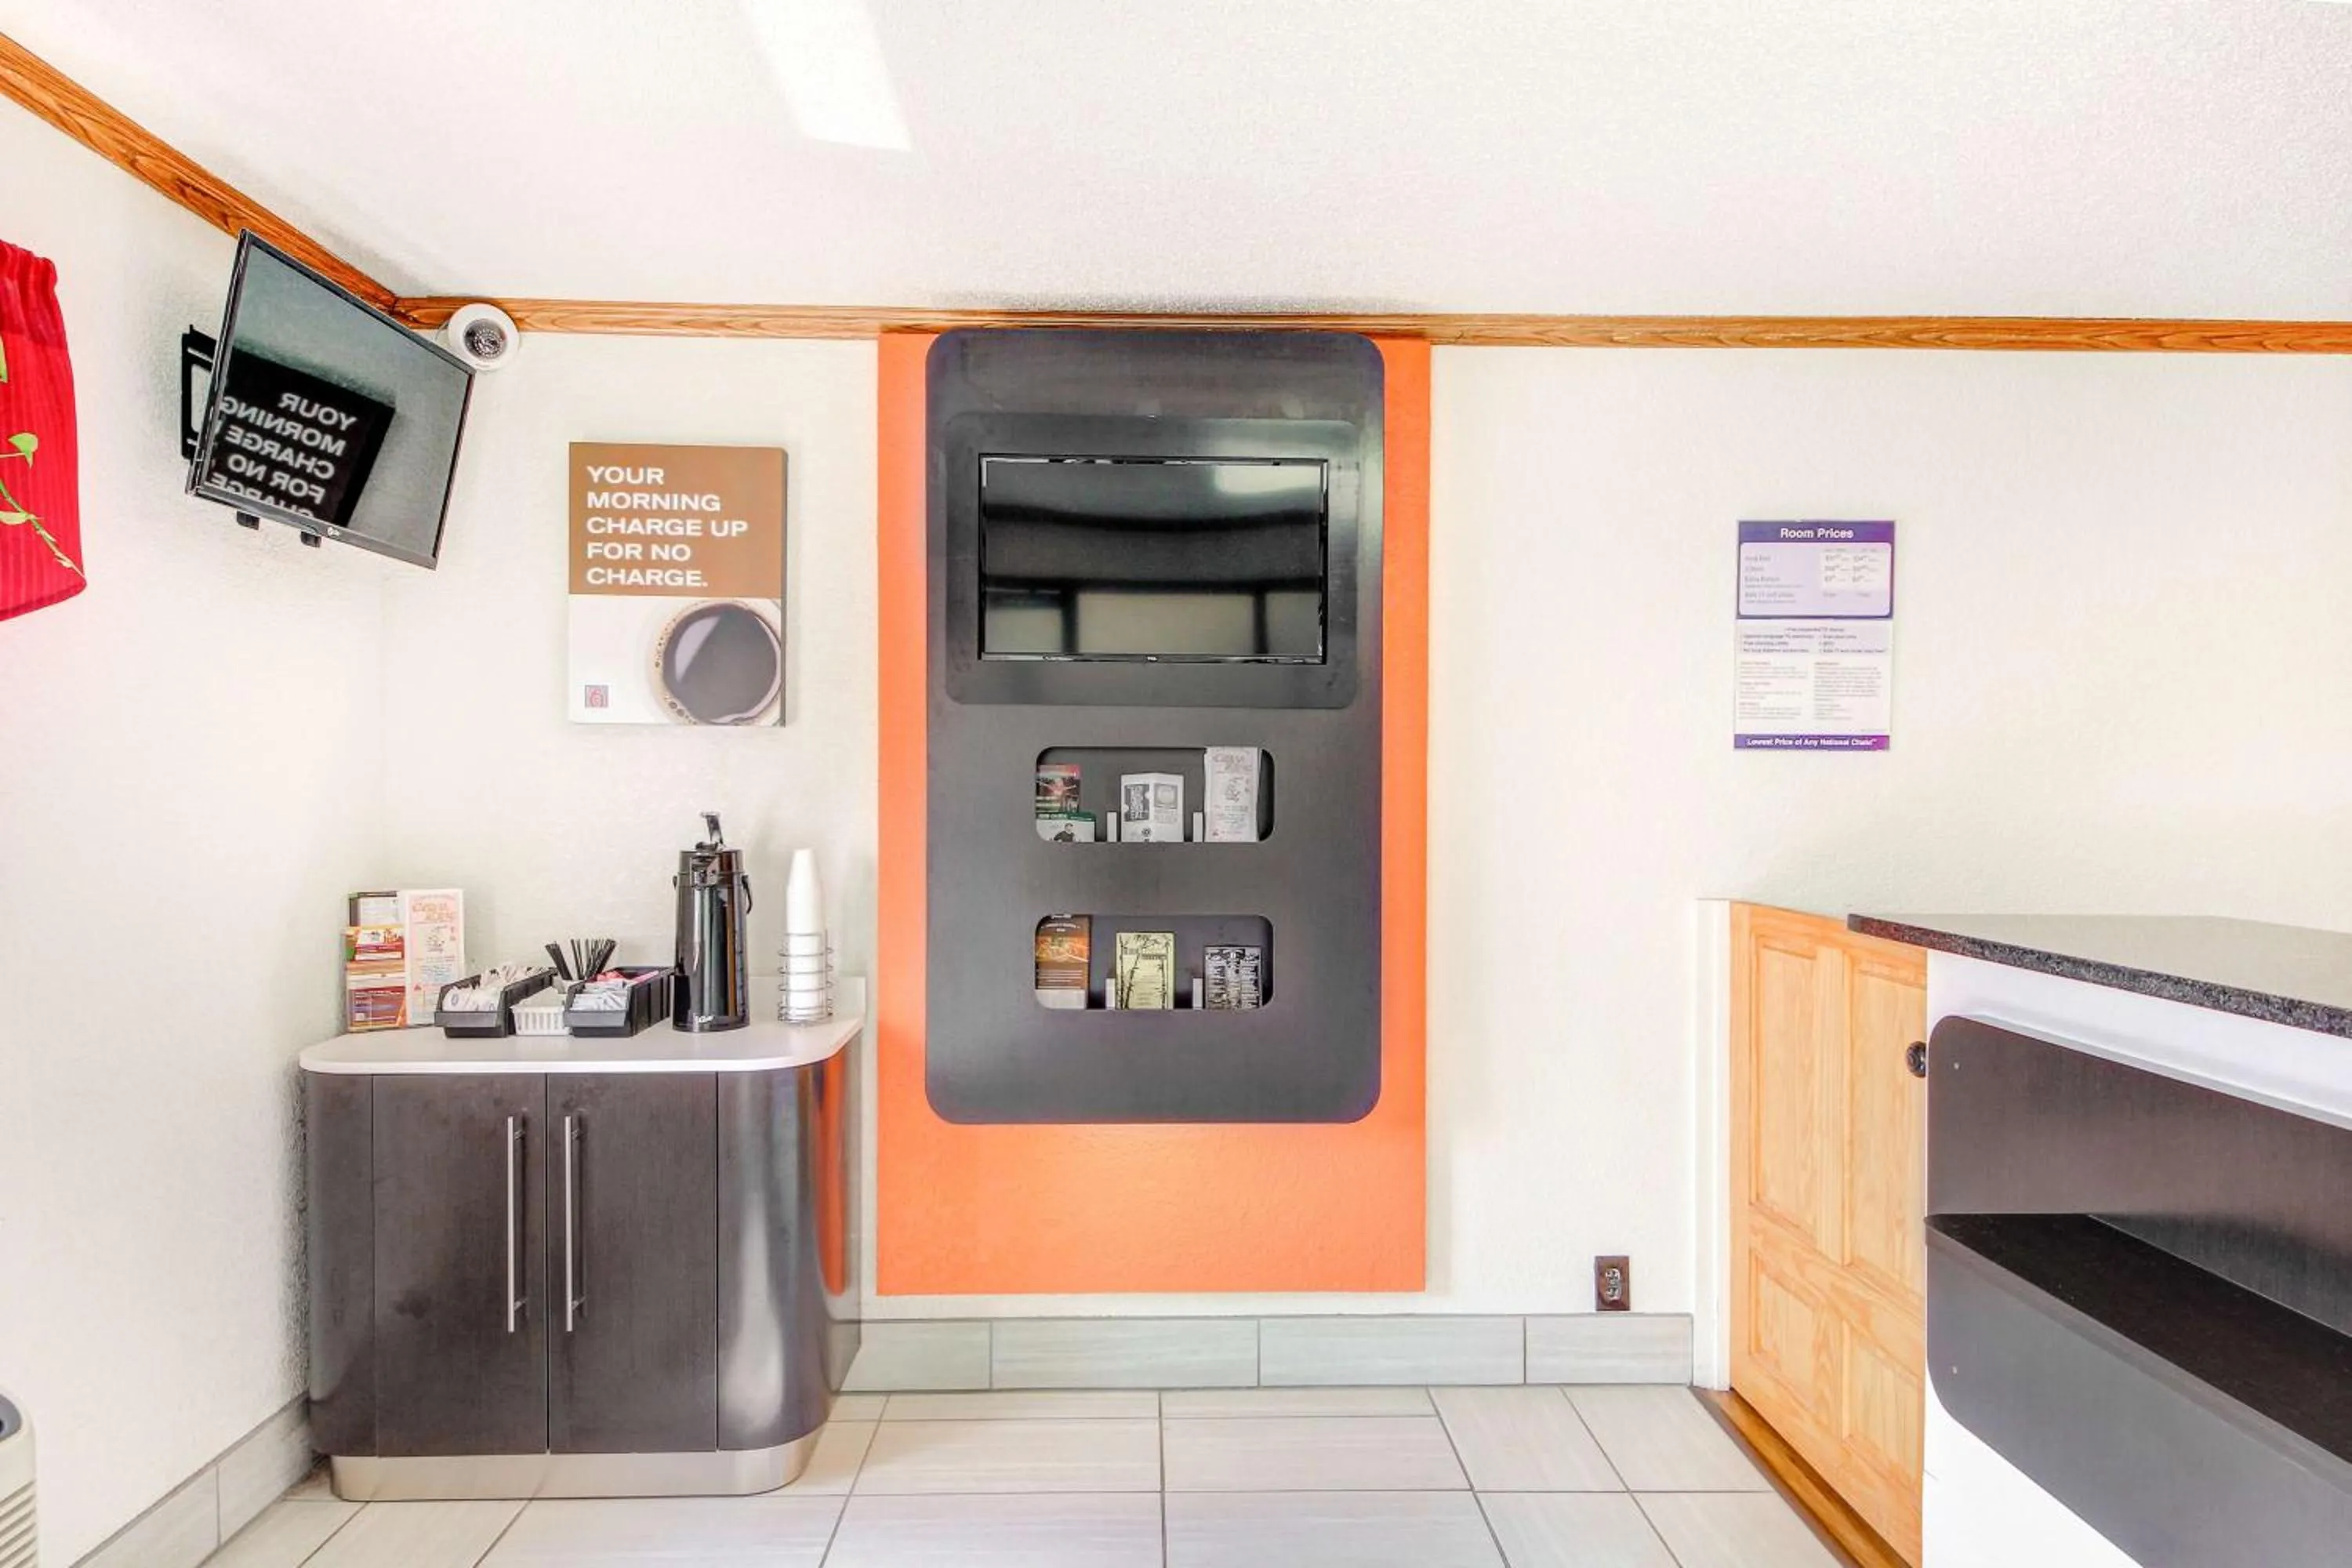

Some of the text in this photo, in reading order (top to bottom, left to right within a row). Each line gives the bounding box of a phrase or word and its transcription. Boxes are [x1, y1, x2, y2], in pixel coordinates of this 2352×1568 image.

[586, 465, 665, 485] YOUR
[586, 491, 721, 513] MORNING
[586, 517, 749, 538] CHARGE UP
[1780, 528, 1854, 539] Room Prices
[586, 541, 691, 562] FOR NO
[586, 567, 709, 588] CHARGE.
